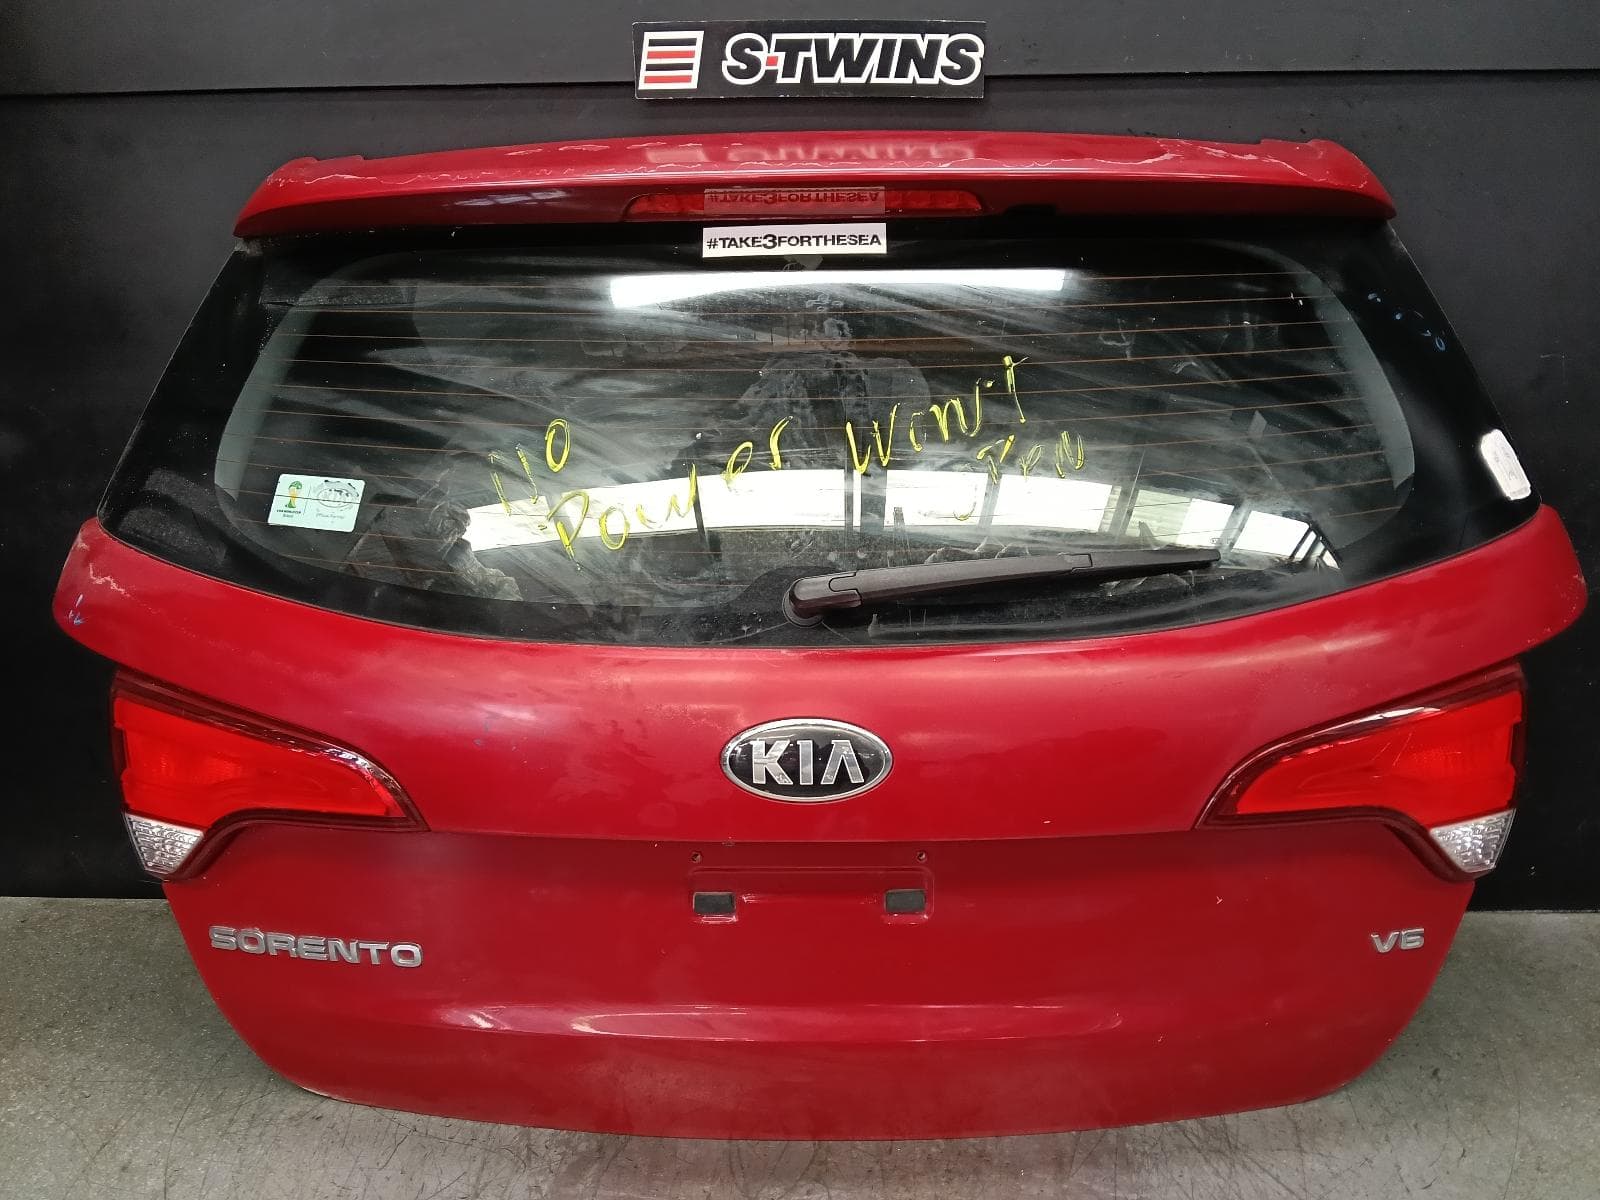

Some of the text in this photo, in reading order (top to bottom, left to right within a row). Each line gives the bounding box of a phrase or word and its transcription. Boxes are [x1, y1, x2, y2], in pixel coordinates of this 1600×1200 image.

[706, 234, 882, 250] #TAKE3FORTHESEA
[750, 739, 865, 786] KIA
[208, 925, 422, 968] SORENTO
[1370, 927, 1425, 954] V6
